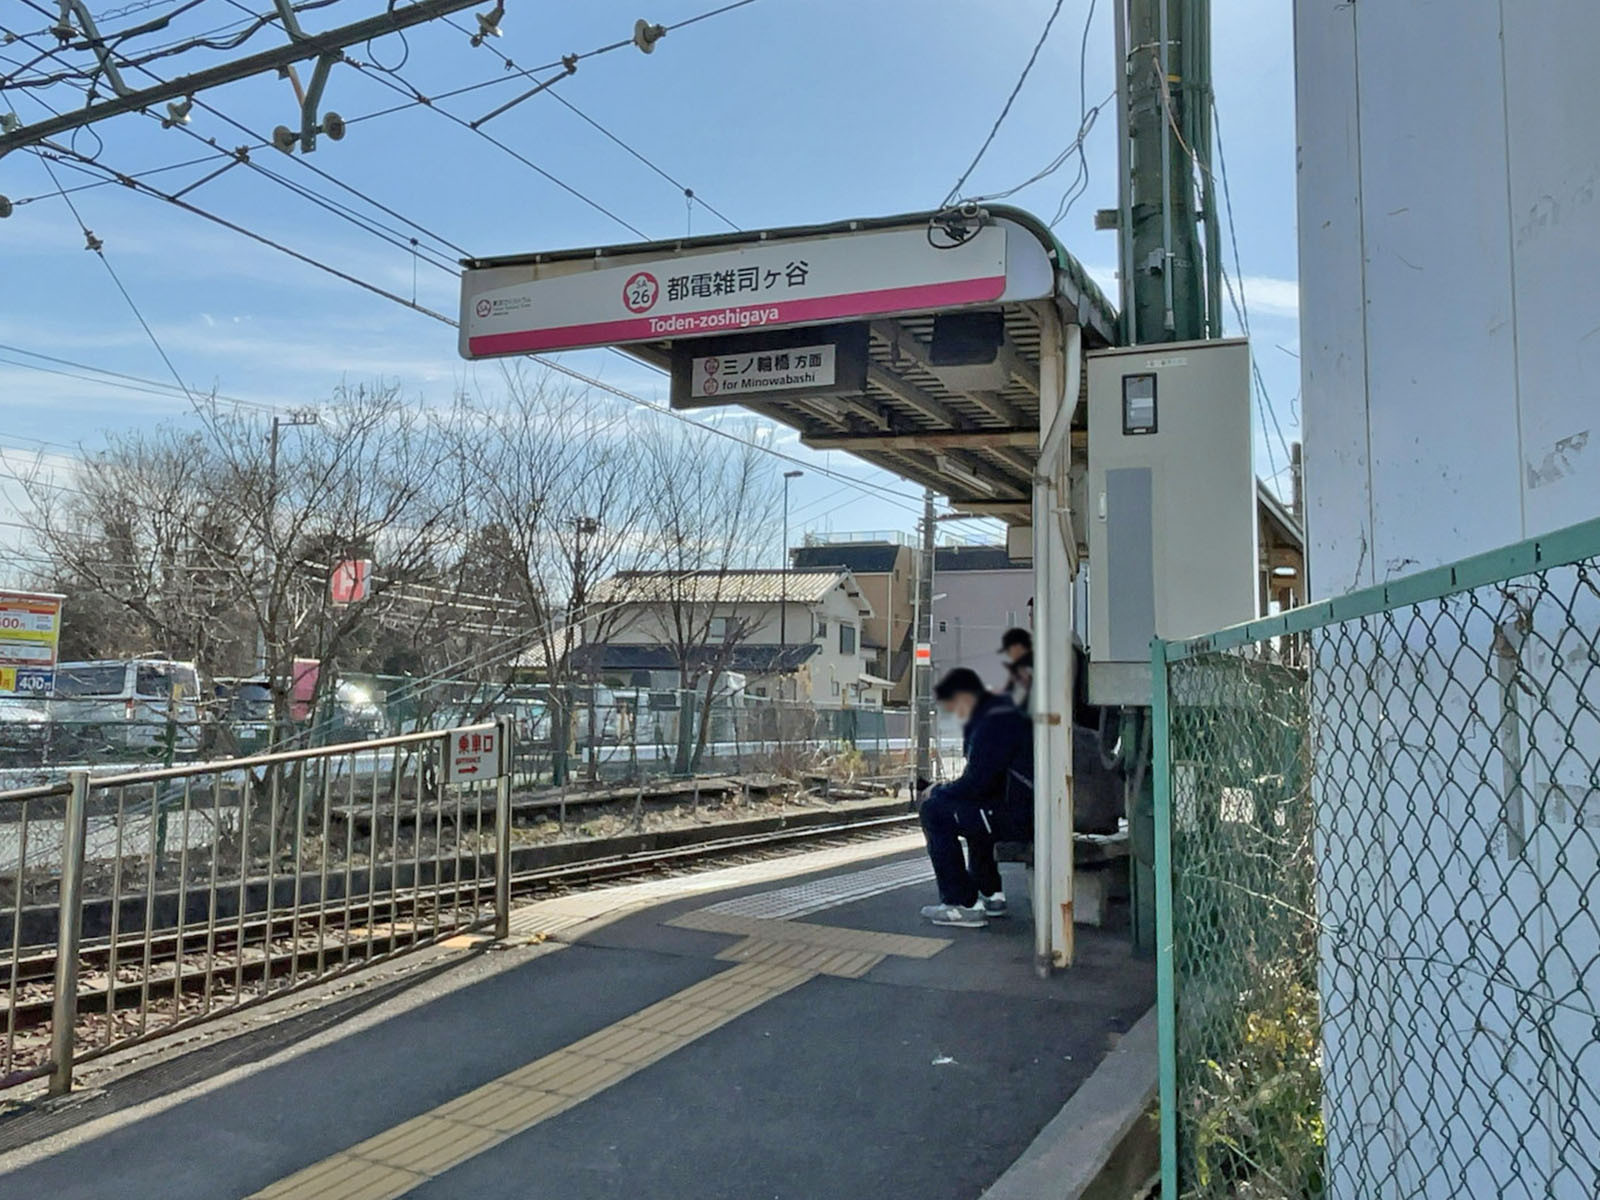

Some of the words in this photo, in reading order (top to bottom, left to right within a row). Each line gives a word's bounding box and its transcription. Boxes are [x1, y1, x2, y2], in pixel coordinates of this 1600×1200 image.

[631, 289, 650, 305] 26
[649, 307, 779, 333] Toden-zoshigaya
[722, 379, 738, 390] for
[741, 372, 816, 389] Minowabashi
